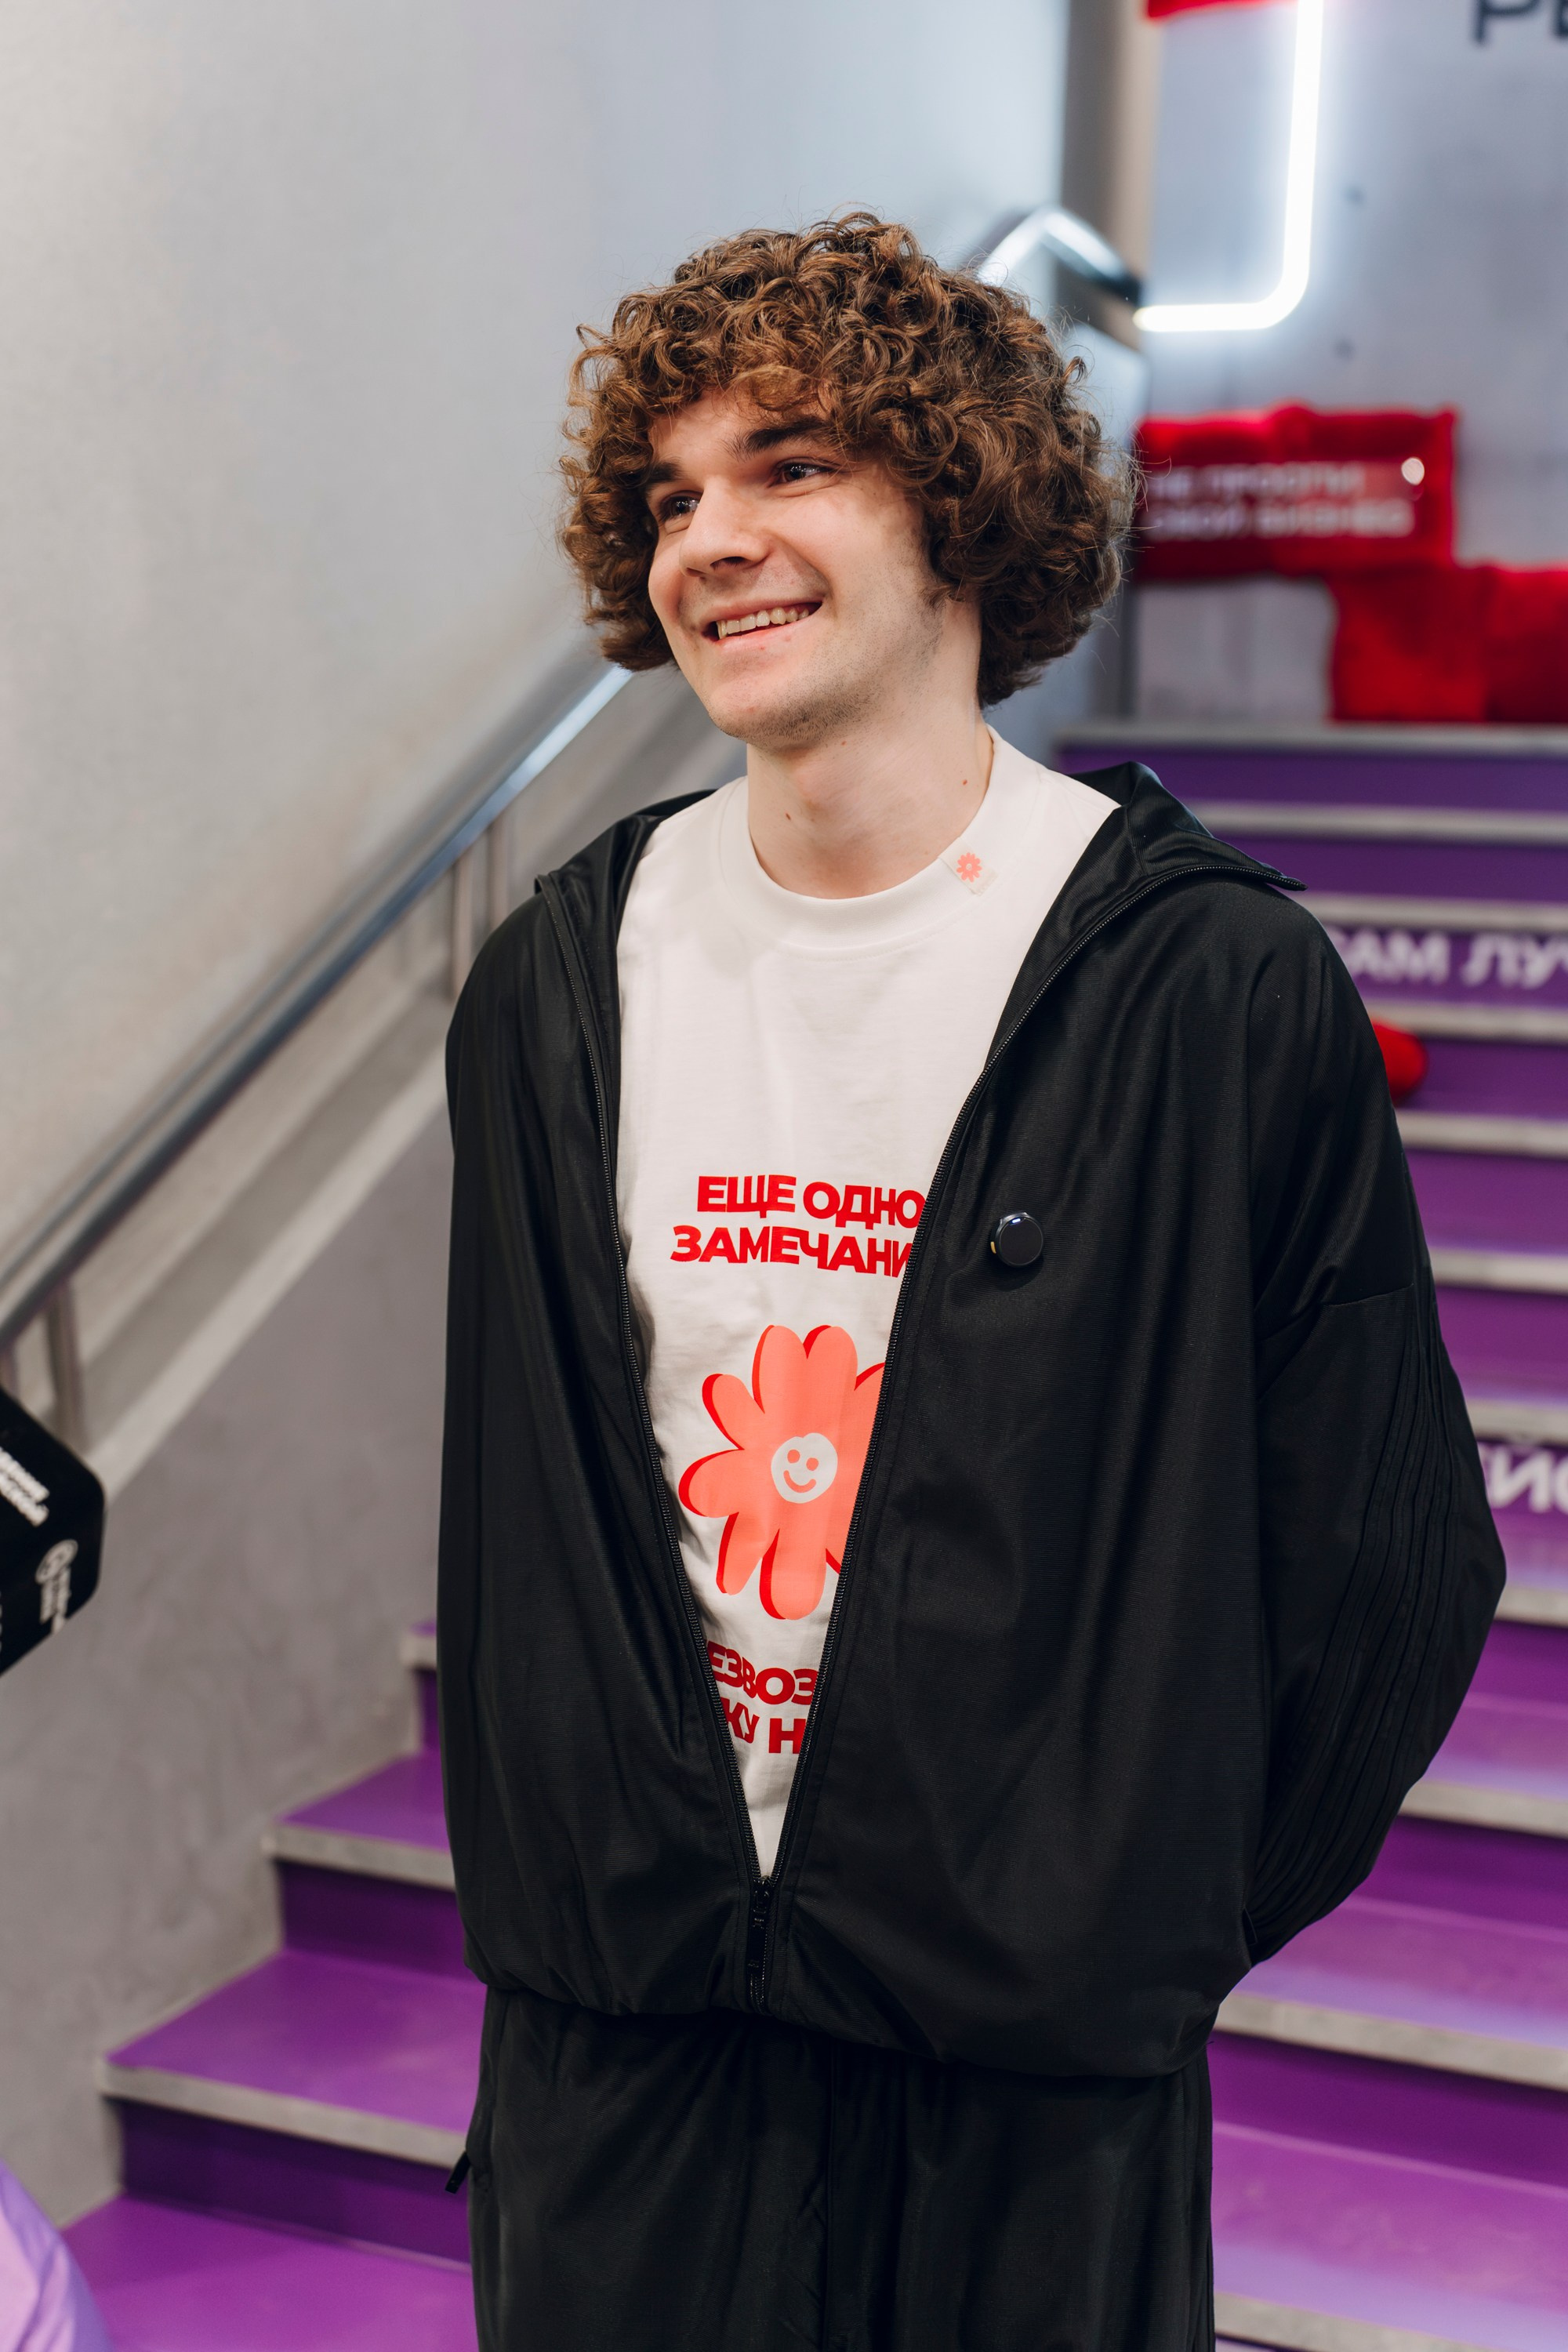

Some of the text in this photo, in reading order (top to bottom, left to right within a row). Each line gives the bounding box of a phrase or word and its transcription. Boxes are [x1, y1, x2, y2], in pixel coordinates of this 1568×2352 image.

[697, 1174, 925, 1230] ЕЩЕ ОДНО
[670, 1225, 913, 1278] ЗАМЕЧАНИ
